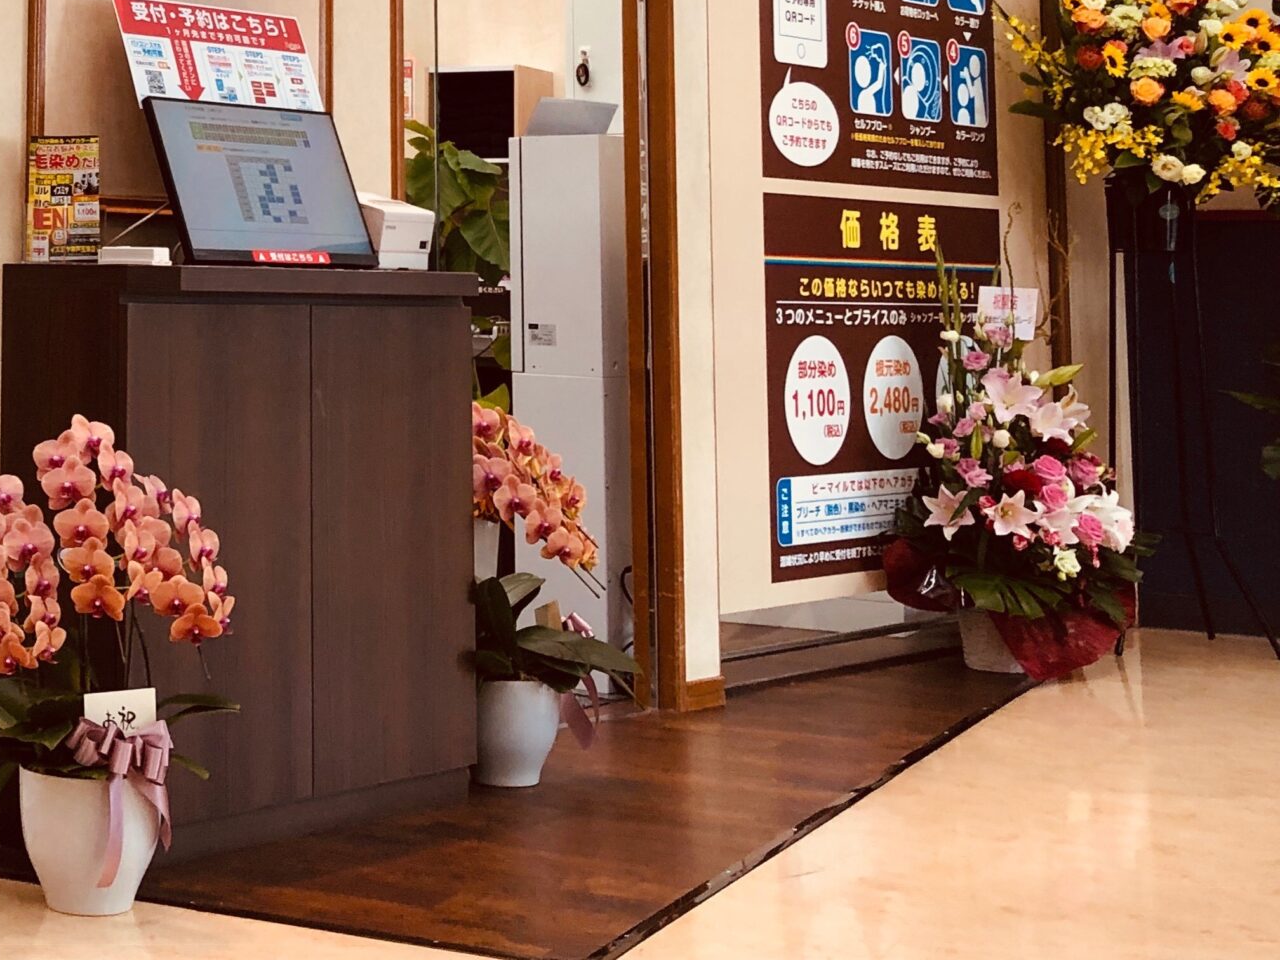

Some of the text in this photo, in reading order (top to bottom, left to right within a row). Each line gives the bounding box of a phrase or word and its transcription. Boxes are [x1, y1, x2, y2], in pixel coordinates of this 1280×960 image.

[130, 1, 288, 38] 受付・予約はこちら!
[785, 10, 816, 26] QRコード
[791, 98, 817, 111] こちらの
[840, 209, 937, 251] 価格表
[799, 278, 975, 300] この価格ならいつでも染める!
[798, 360, 836, 379] 部分染め
[875, 360, 911, 377] 根元染め
[792, 388, 845, 420] 1,100円
[869, 385, 919, 416] 2,480円
